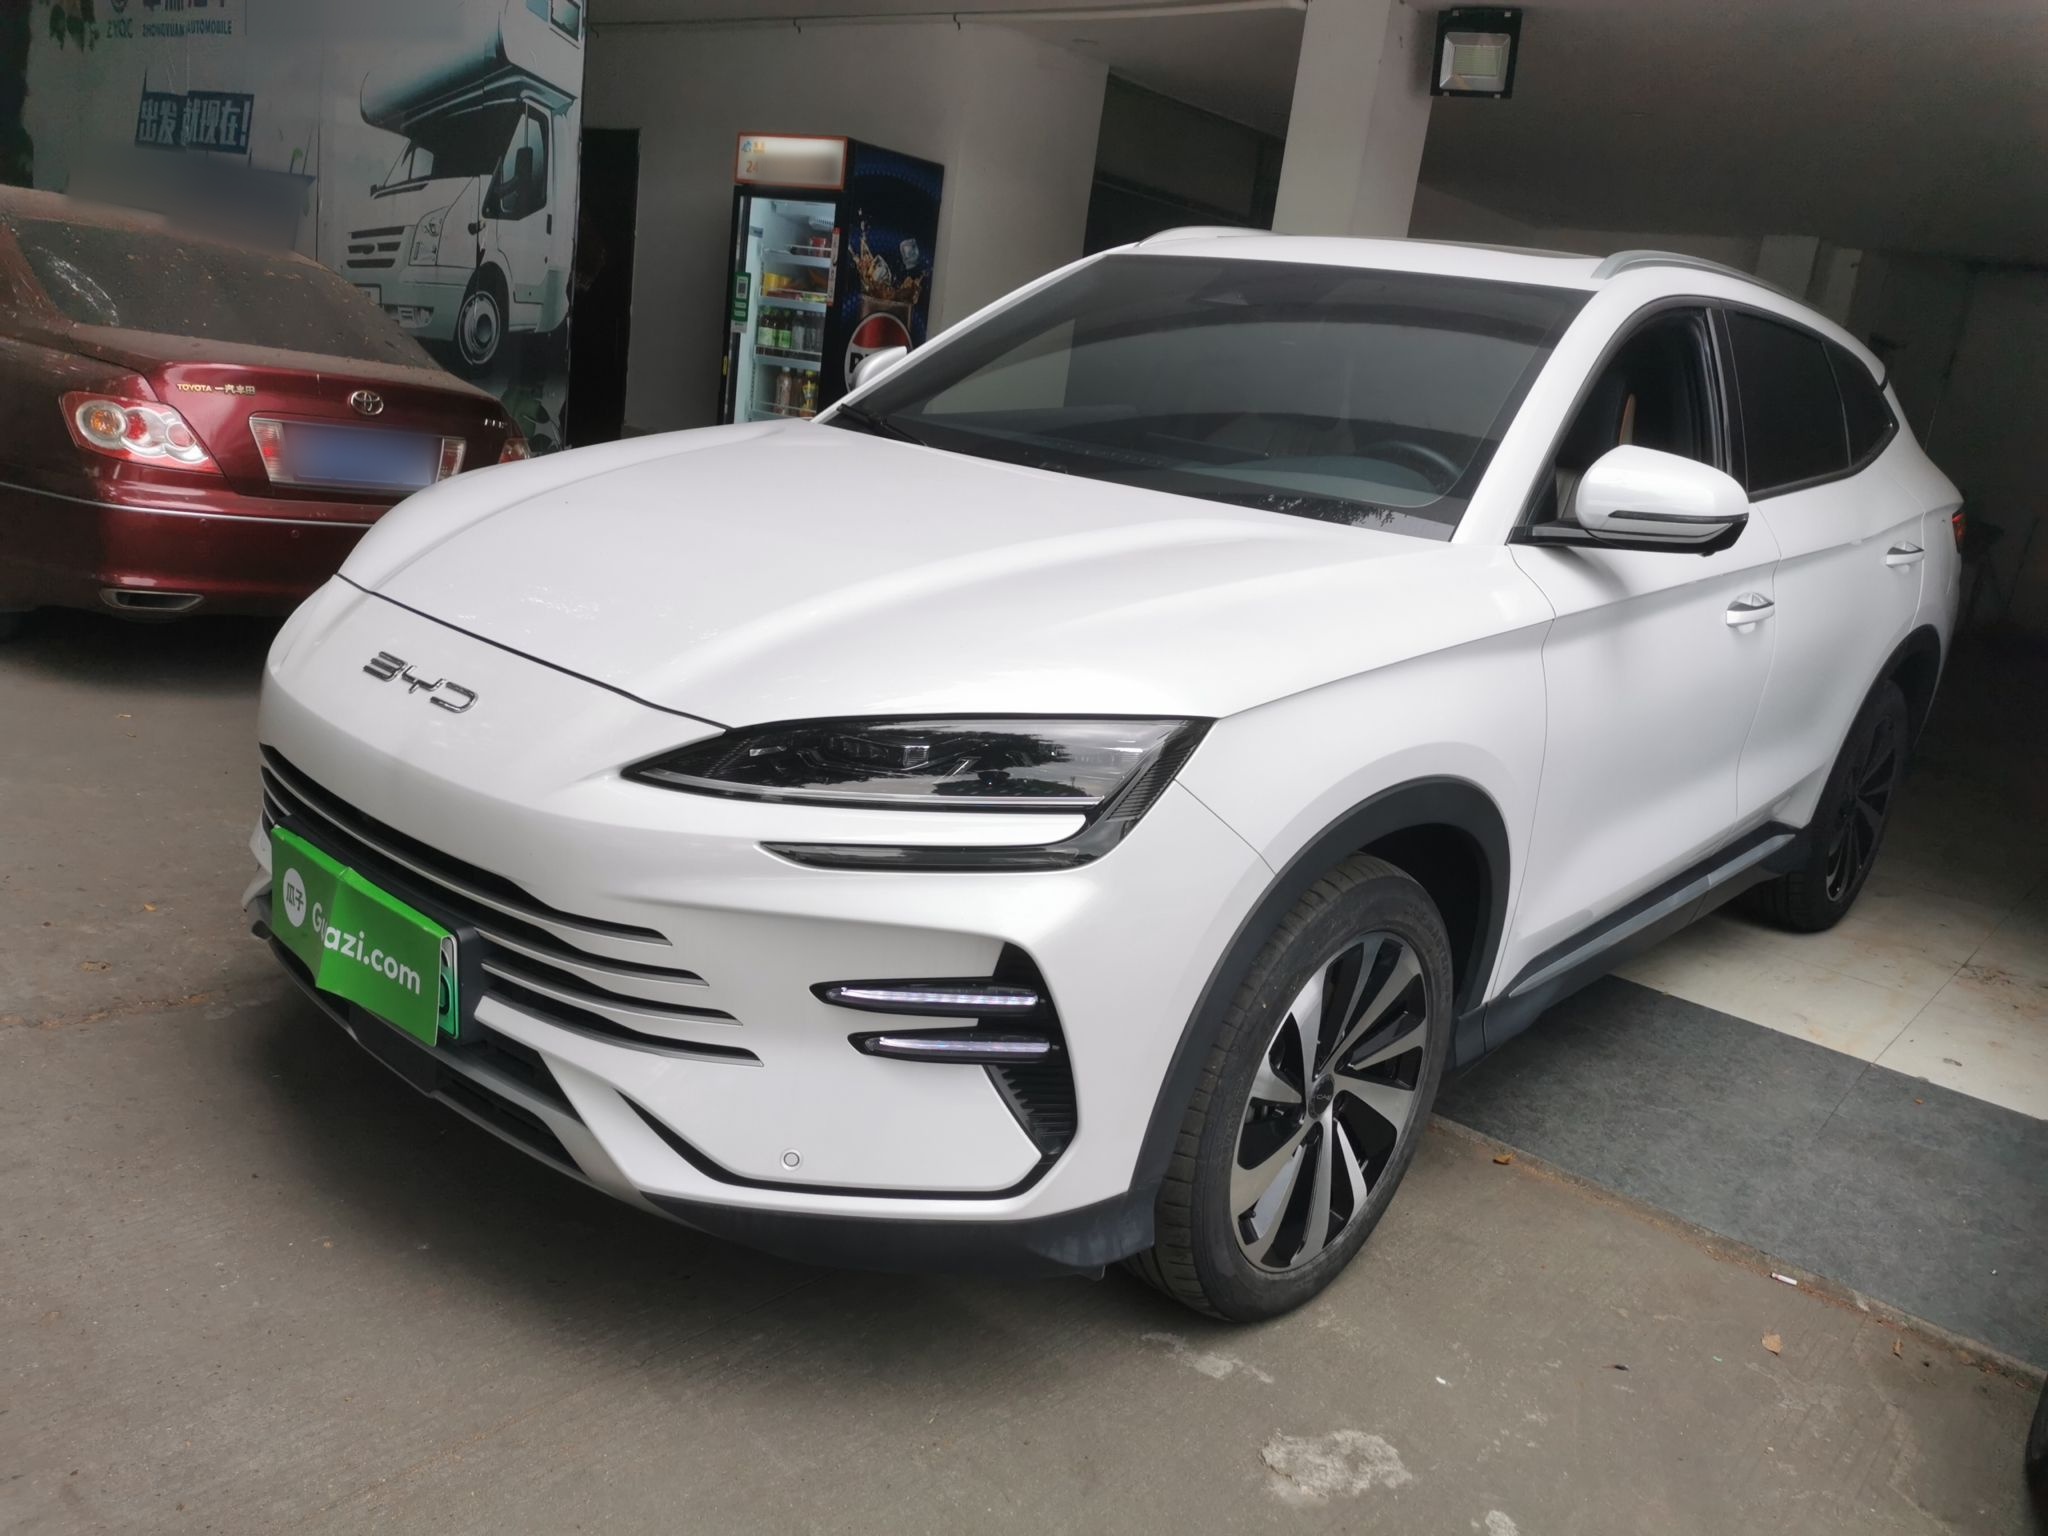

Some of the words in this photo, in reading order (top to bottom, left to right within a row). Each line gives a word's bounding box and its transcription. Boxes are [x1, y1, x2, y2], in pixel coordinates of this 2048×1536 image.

[187, 19, 232, 35] AUTOMOBILE
[177, 383, 212, 392] TOYOTA
[363, 651, 478, 713] BYD
[286, 882, 304, 911] 瓜子
